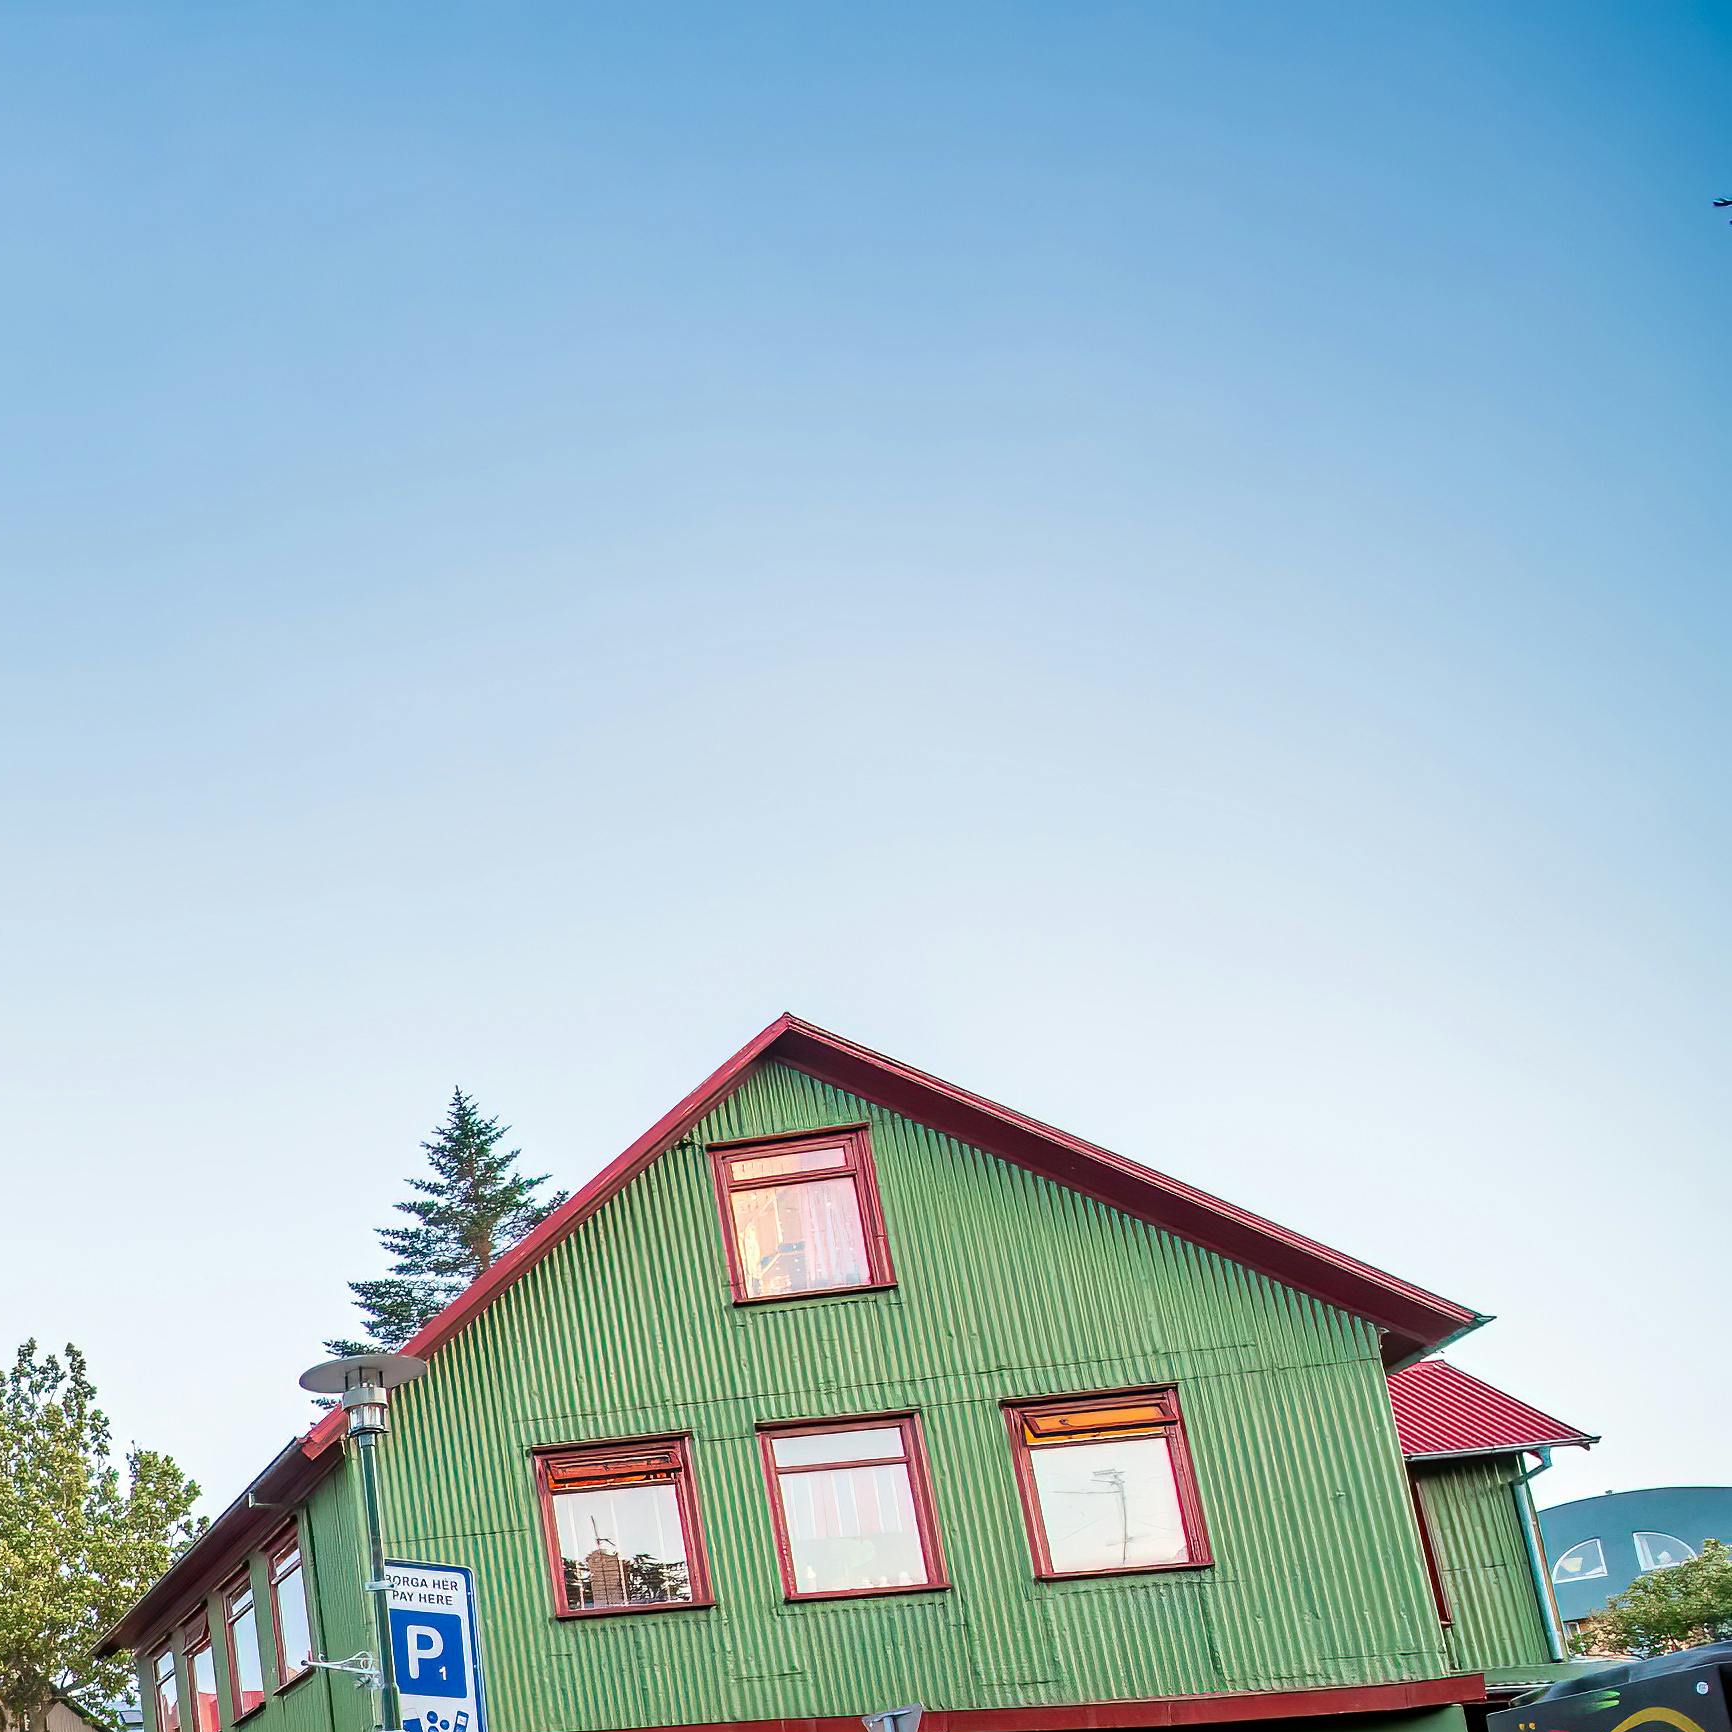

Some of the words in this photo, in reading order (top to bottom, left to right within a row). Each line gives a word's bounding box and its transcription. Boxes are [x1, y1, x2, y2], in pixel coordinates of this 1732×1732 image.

[392, 1590, 414, 1602] PAY
[418, 1593, 454, 1606] HERE
[406, 1624, 444, 1679] P
